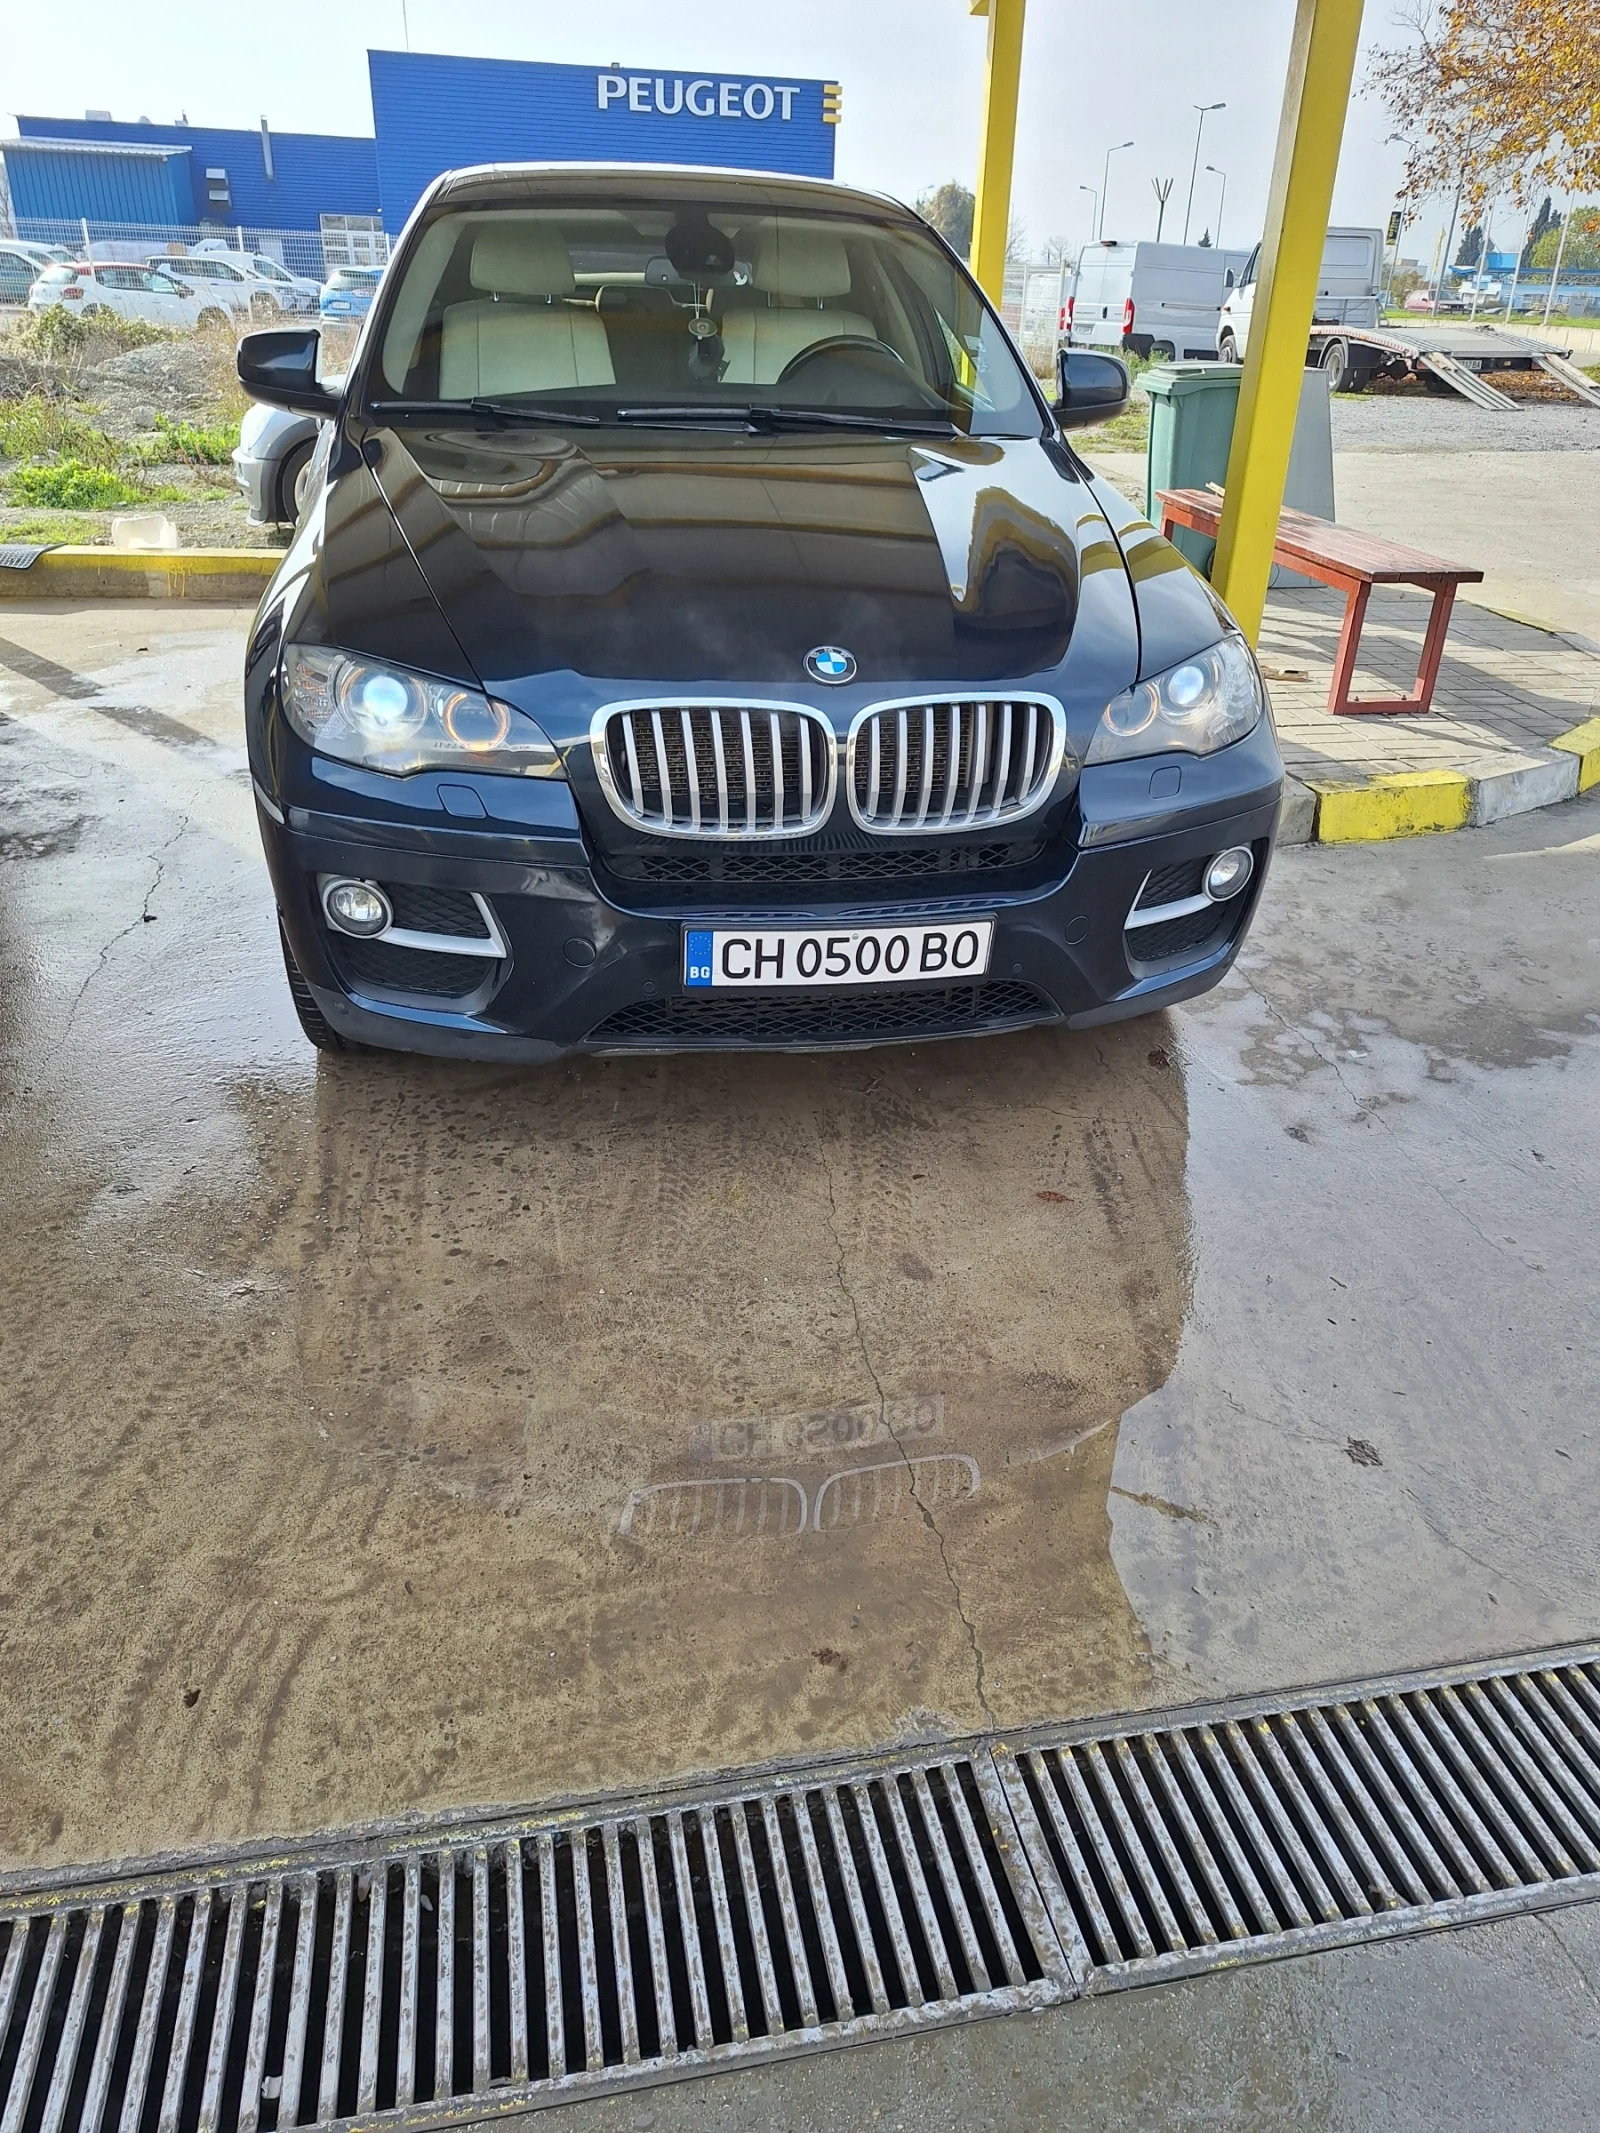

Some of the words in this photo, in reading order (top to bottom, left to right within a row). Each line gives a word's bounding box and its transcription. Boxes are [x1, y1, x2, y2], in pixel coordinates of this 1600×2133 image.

[597, 74, 800, 121] PEUGEOT
[690, 966, 710, 979] BG
[721, 938, 784, 979] CH
[796, 935, 910, 978] 0500
[919, 931, 979, 972] BO
